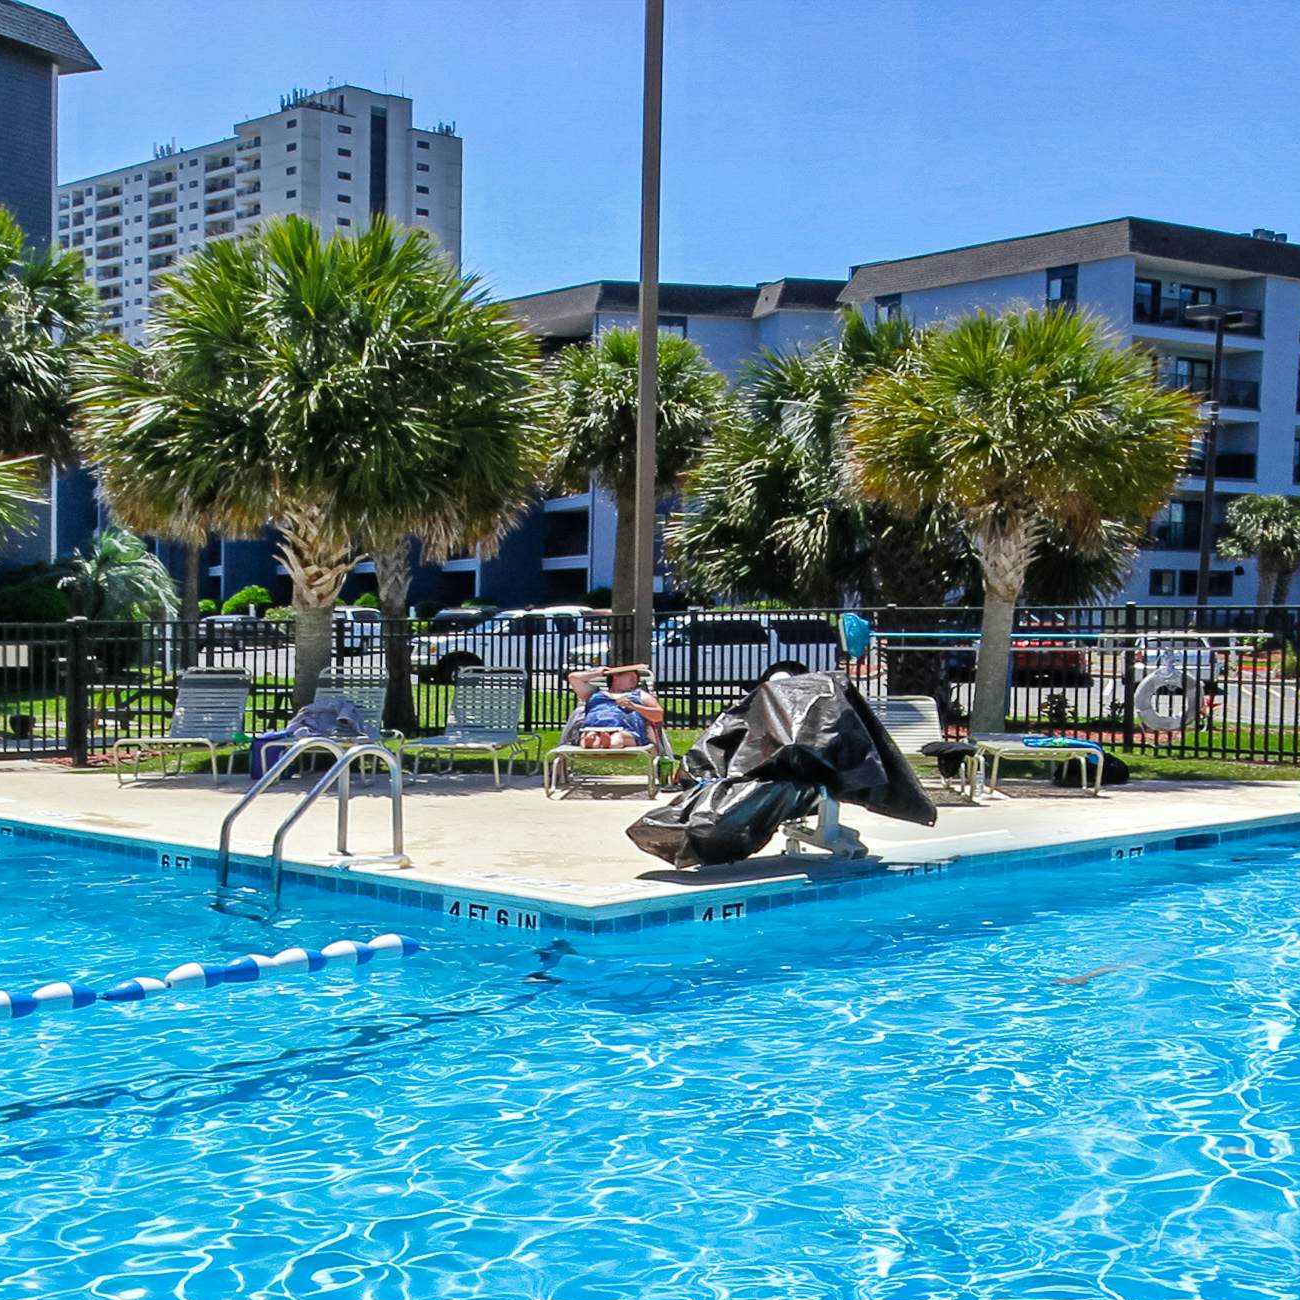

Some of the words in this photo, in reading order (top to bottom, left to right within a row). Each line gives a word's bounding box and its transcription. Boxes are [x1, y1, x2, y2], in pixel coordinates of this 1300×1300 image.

[449, 901, 460, 916] 4
[469, 904, 489, 921] FT
[497, 909, 509, 925] 6
[518, 913, 537, 929] IN
[723, 902, 744, 919] FT
